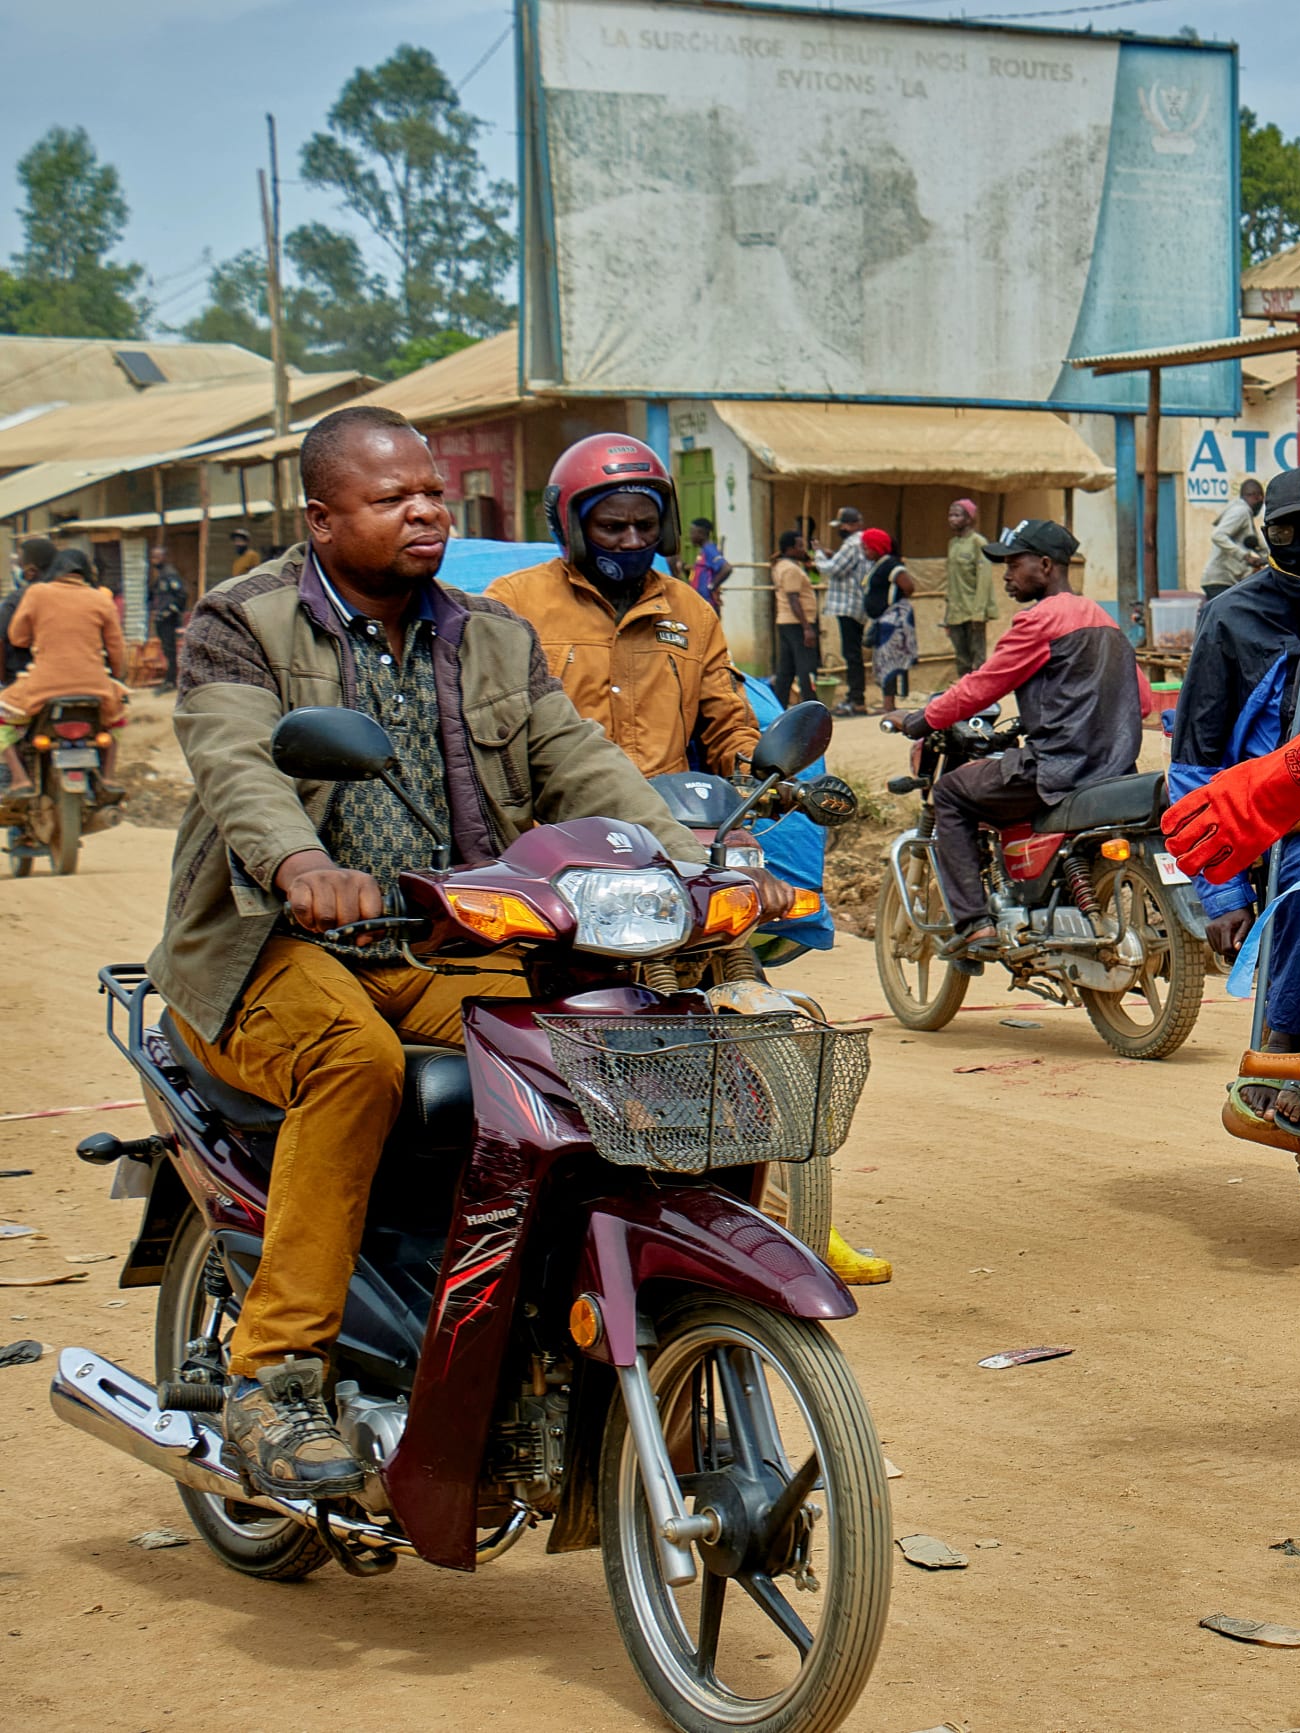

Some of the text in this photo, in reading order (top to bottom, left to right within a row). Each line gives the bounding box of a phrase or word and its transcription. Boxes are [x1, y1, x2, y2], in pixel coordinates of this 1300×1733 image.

[601, 27, 629, 49] LA
[639, 29, 785, 58] SURCHARGE
[914, 50, 967, 73] NOS
[1188, 478, 1229, 496] MOTO
